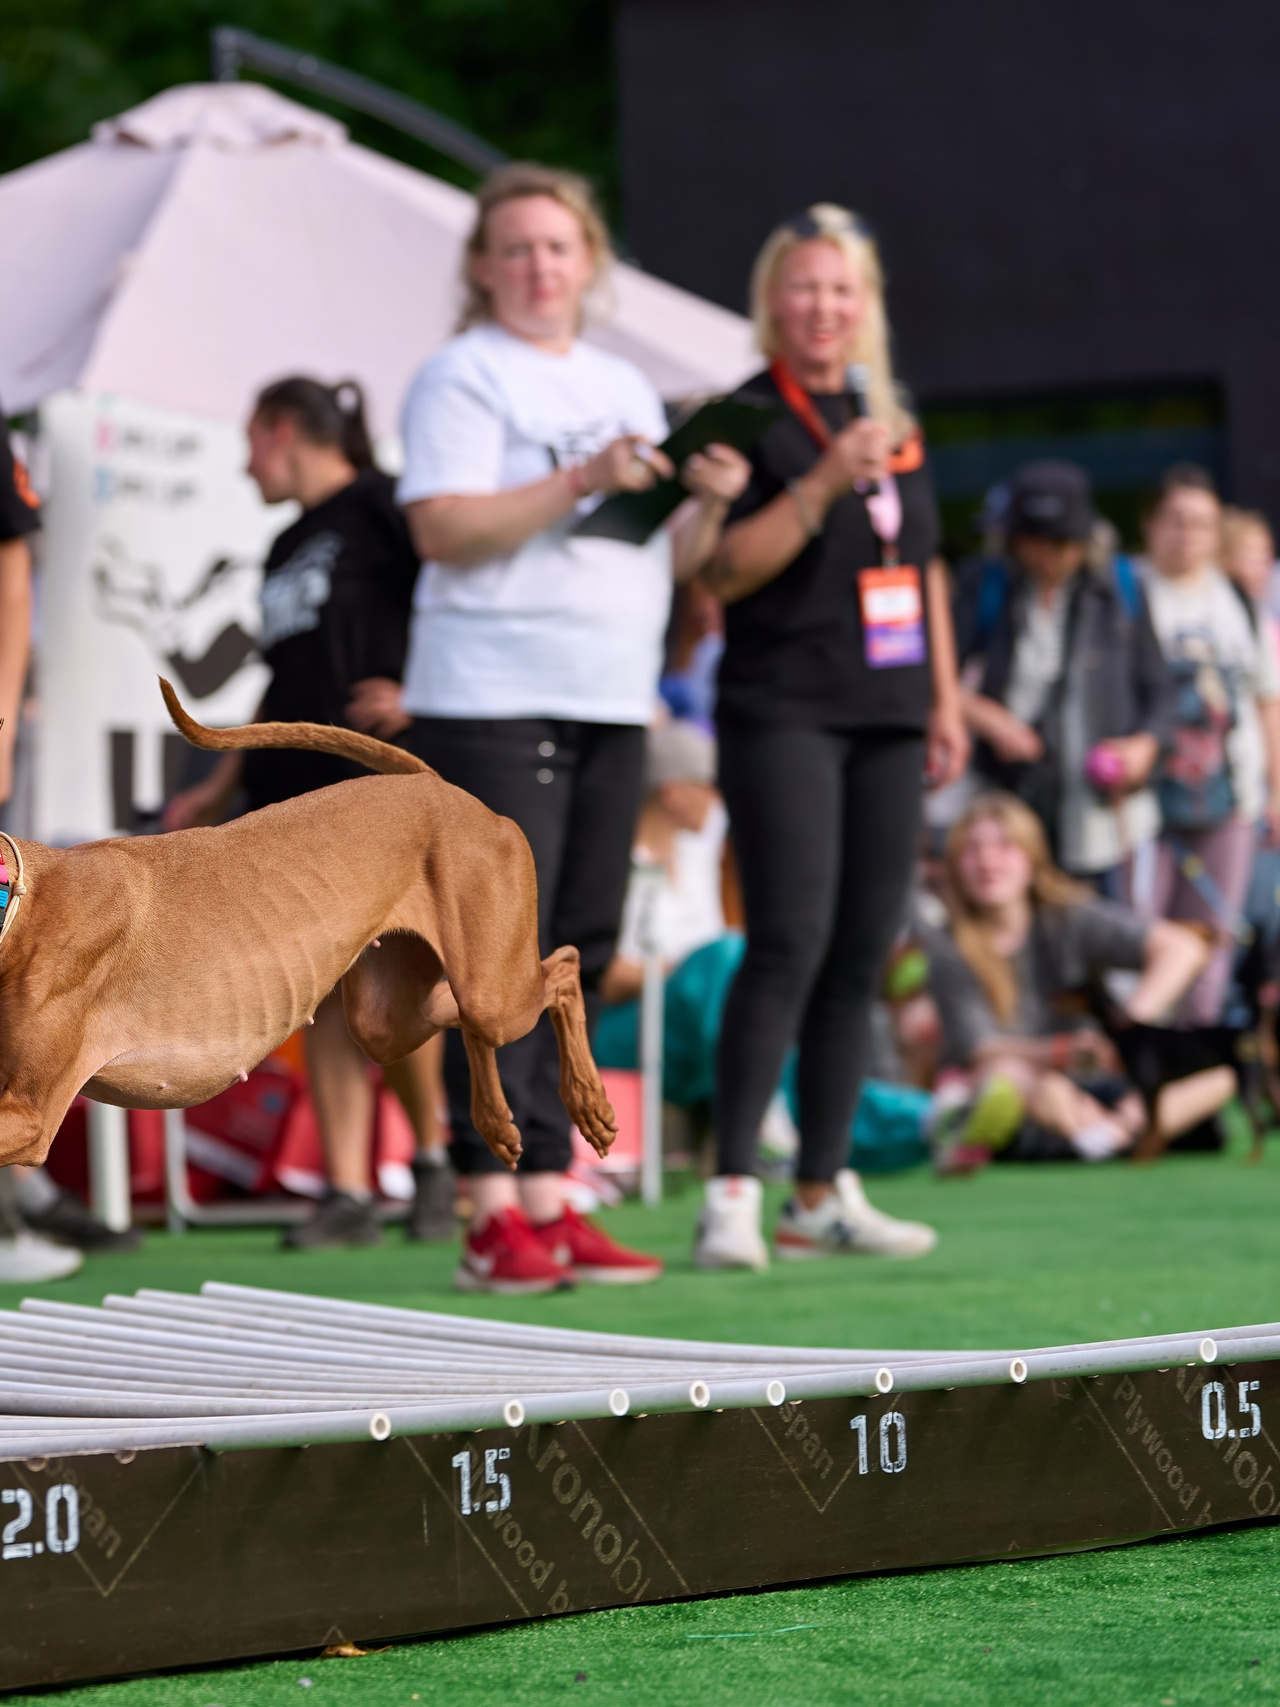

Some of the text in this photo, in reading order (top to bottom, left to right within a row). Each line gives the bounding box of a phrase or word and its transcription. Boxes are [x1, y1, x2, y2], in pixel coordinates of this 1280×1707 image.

[1201, 1379, 1262, 1441] 0.5
[451, 1447, 512, 1516] 1.5
[0, 1483, 81, 1561] 2.0
